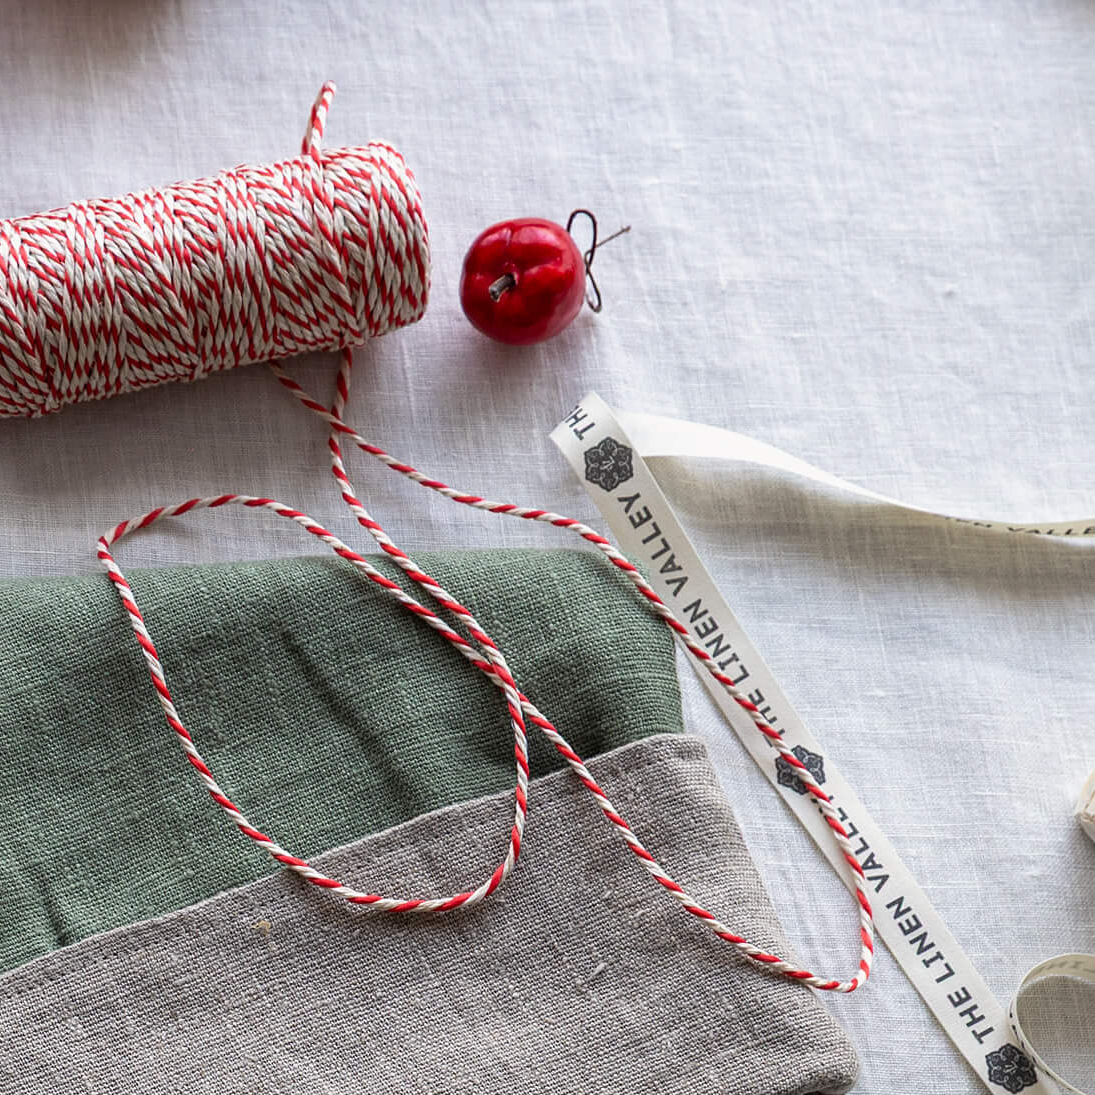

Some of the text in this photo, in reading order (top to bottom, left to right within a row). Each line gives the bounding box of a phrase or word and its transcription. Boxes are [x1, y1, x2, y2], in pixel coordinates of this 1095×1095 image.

[563, 405, 595, 440] TH
[616, 492, 689, 597] VALLEY
[682, 598, 750, 686] LINEN
[885, 895, 955, 984] LINEN
[947, 986, 995, 1045] THE
